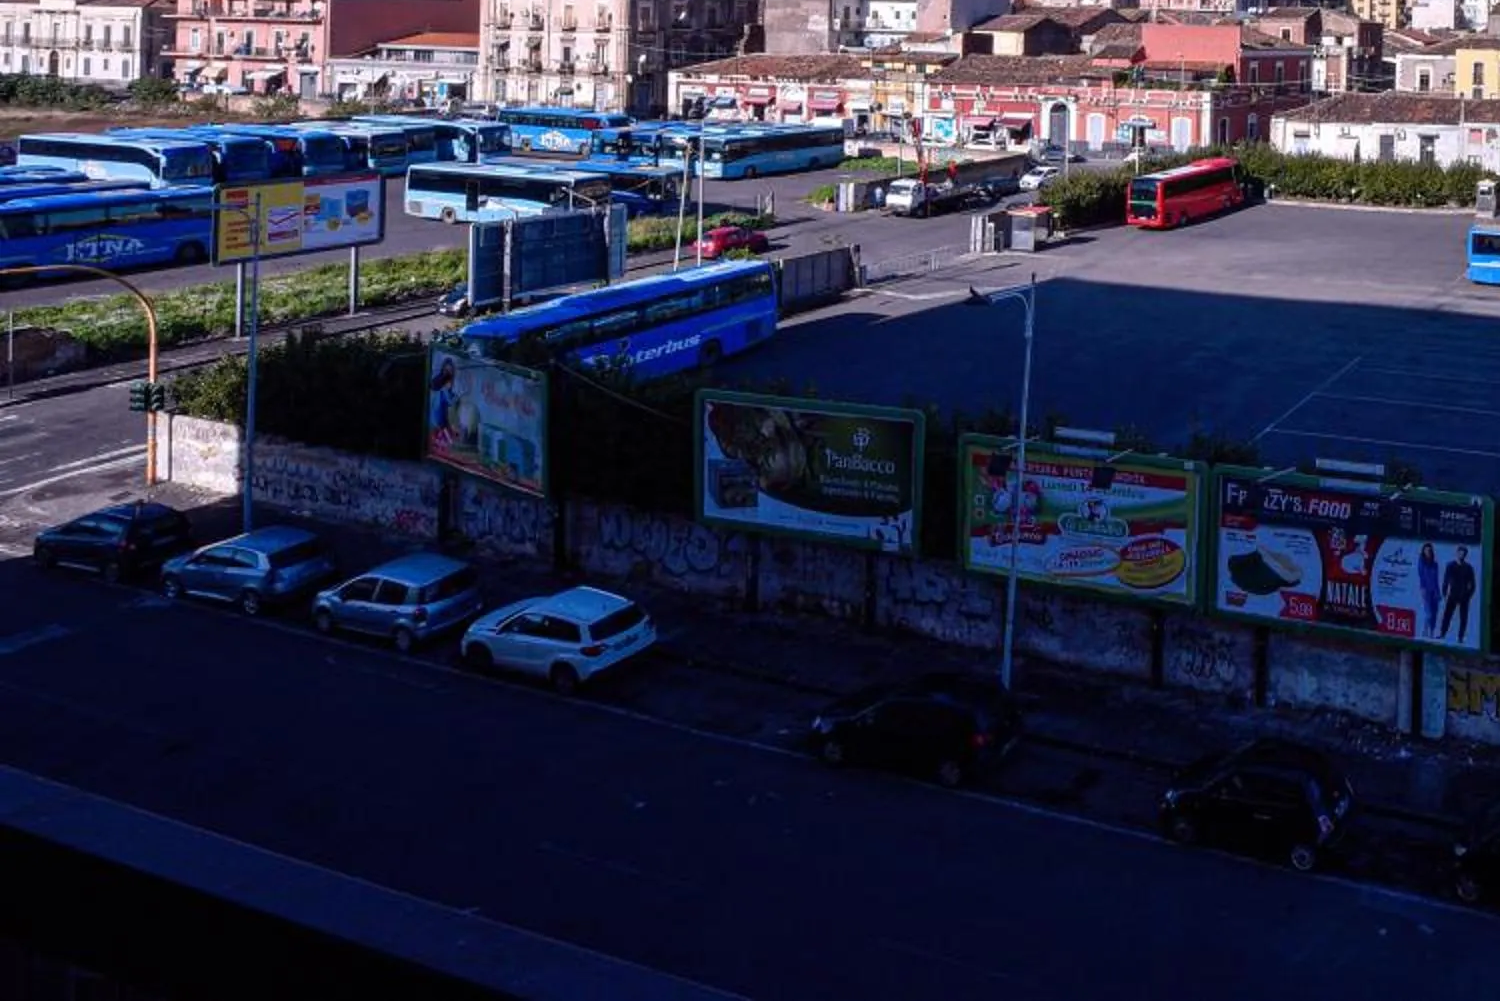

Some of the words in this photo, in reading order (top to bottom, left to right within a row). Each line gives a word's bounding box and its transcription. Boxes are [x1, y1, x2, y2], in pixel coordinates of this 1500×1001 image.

[65, 238, 146, 263] ETNA
[1308, 498, 1351, 521] FOOD
[1327, 580, 1368, 609] NATALE
